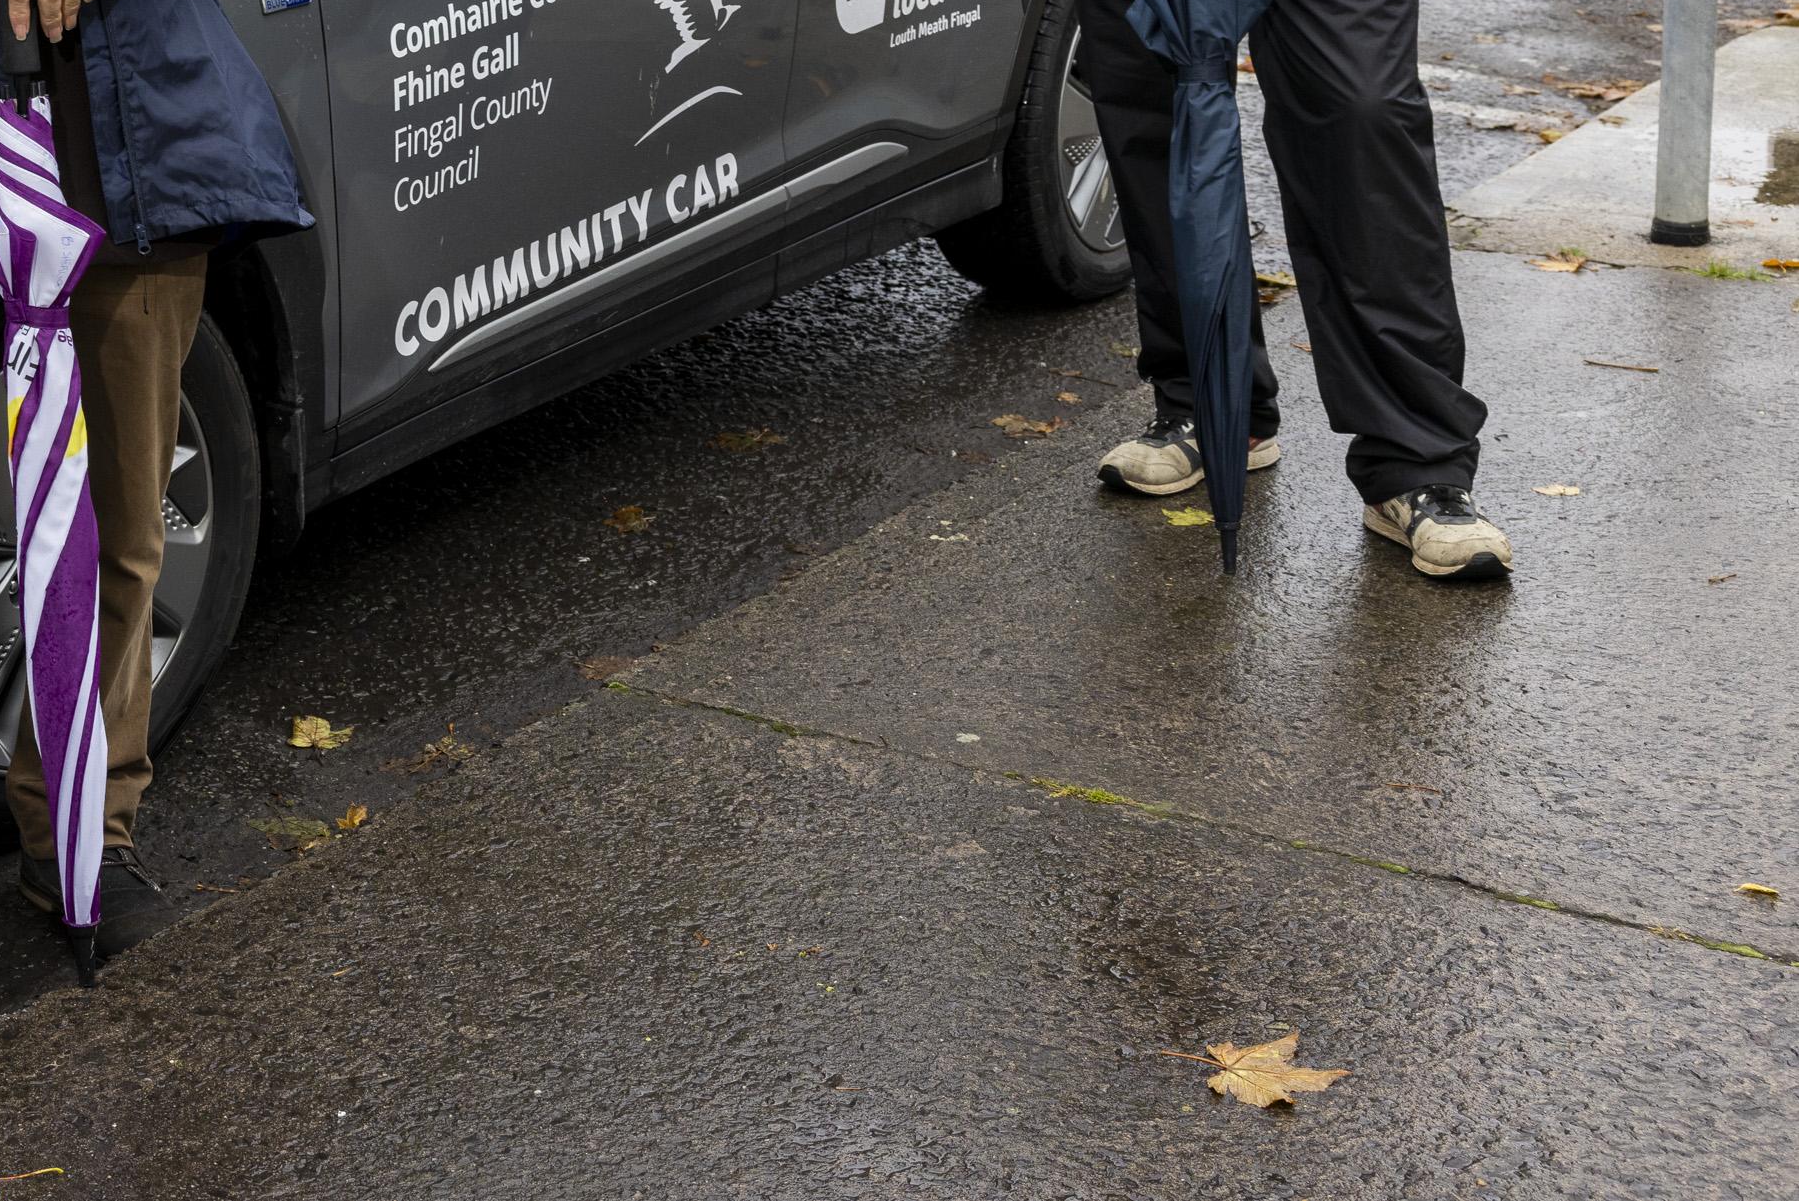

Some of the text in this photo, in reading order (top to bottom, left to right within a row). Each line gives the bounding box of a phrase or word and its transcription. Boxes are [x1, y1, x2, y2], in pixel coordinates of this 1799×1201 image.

[890, 4, 981, 48] Louth Meath Fingal
[393, 32, 519, 112] Fhine Gall
[394, 77, 552, 163] Fingal County
[394, 145, 479, 212] Council
[394, 152, 739, 357] COMMUNITY CAR
